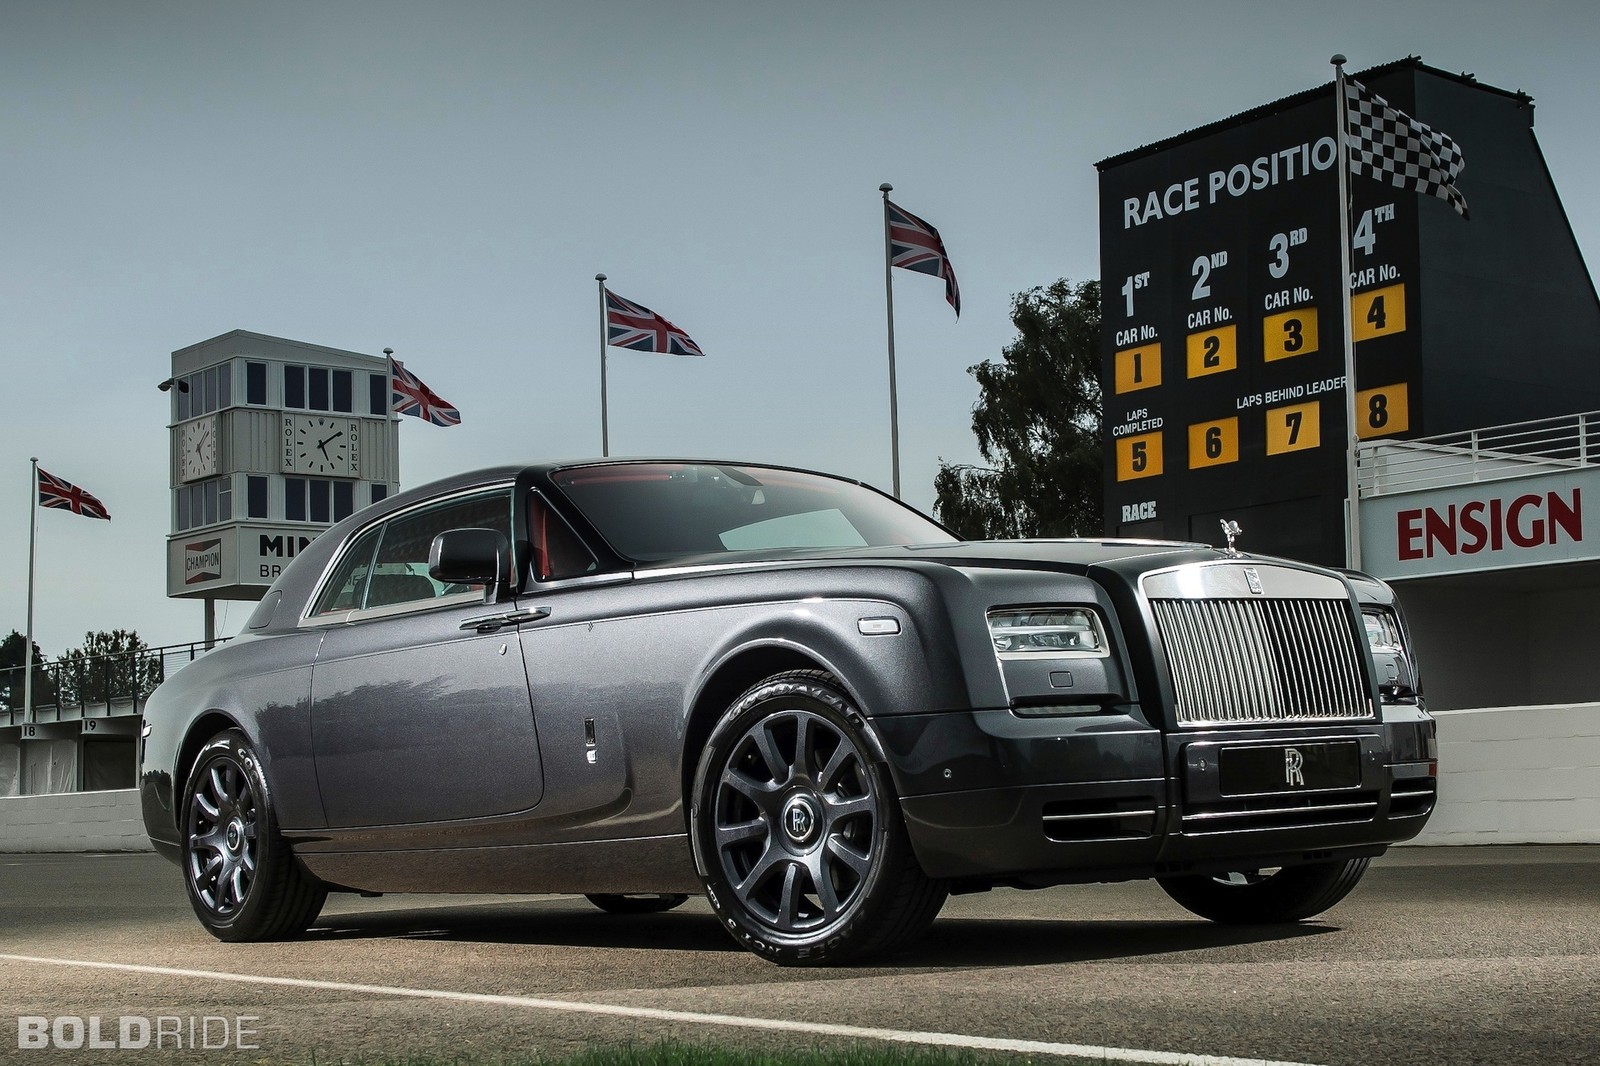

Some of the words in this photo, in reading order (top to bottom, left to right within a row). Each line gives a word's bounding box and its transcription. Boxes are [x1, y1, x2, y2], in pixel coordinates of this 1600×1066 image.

[1124, 178, 1200, 229] RACE
[1353, 203, 1395, 255] 4TH
[1268, 227, 1308, 279] 3RD
[1191, 250, 1228, 301] 2ND
[1349, 267, 1376, 289] CAR
[1380, 264, 1400, 282] No.
[1121, 271, 1150, 318] 1ST
[1265, 291, 1289, 310] CAR
[1292, 287, 1314, 304] No.
[1188, 309, 1211, 329] CAR
[1214, 306, 1233, 322] No.
[1367, 295, 1386, 330] 4
[1116, 327, 1138, 347] CAR
[1141, 324, 1158, 340] No.
[1283, 319, 1304, 352] 3
[1204, 336, 1220, 368] 2
[1133, 353, 1142, 384] 1
[1236, 393, 1262, 409] LAPS
[1265, 385, 1304, 404] BEHIND
[1368, 394, 1388, 429] 8
[1112, 417, 1164, 436] COMPLETED
[1126, 408, 1148, 421] LAPS
[1285, 411, 1303, 445] 7
[284, 418, 293, 467] ROLEX
[350, 423, 358, 472] ROLEX
[1131, 441, 1147, 472] 5
[1205, 426, 1222, 459] 6
[1122, 501, 1157, 522] RACE
[1397, 487, 1583, 561] ENSIGN
[186, 551, 220, 571] CHAMPION
[24, 726, 36, 737] 18
[85, 721, 97, 731] 19
